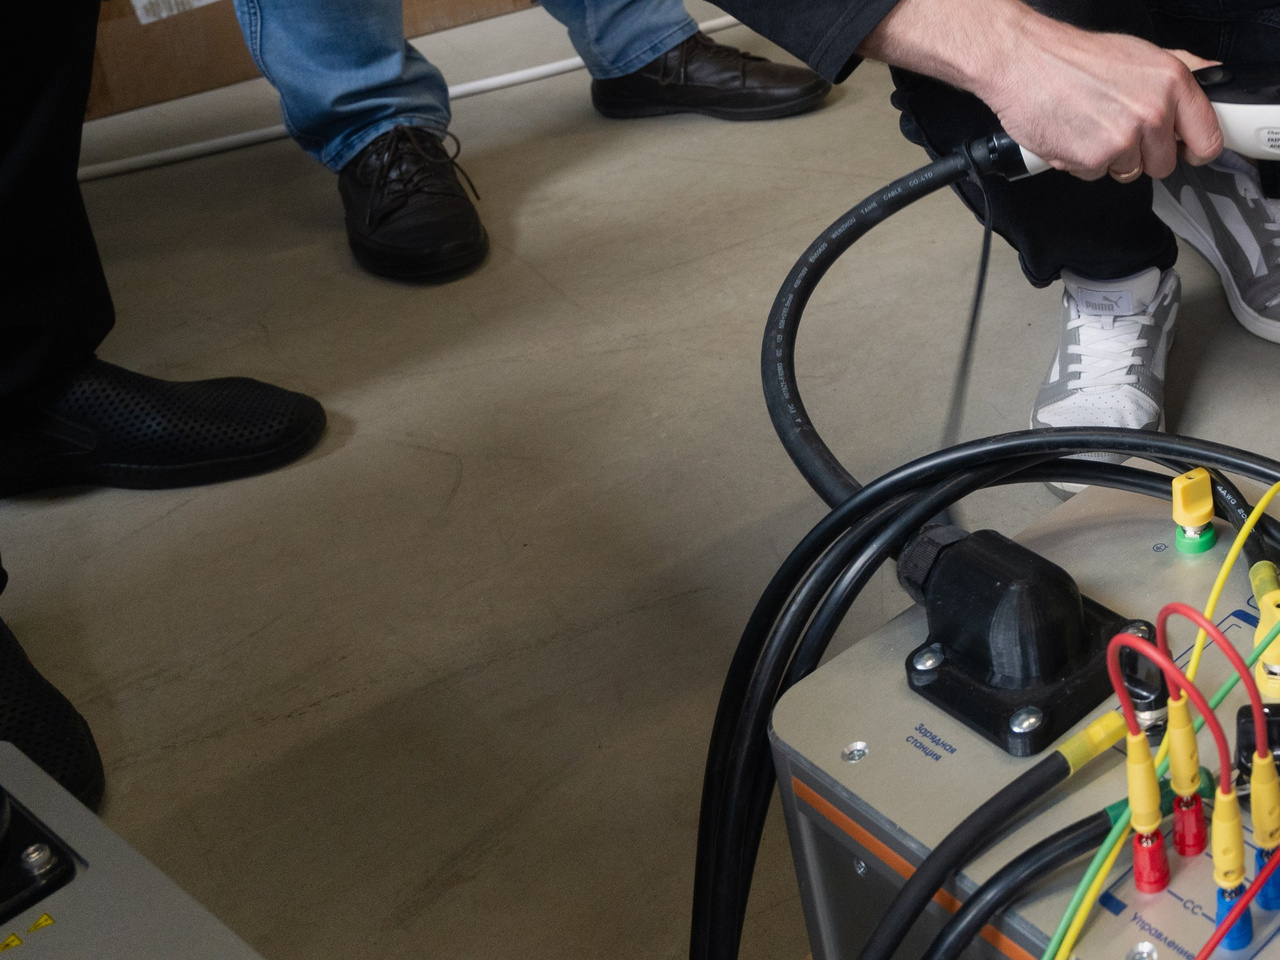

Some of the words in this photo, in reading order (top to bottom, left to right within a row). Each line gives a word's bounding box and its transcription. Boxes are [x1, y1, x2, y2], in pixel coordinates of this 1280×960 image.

[830, 216, 856, 239] WENZHOU
[883, 187, 903, 201] CABLE
[1085, 300, 1114, 311] PUMA
[1217, 485, 1237, 505] 4AWG
[905, 735, 942, 761] станция
[914, 723, 957, 754] Зарядная
